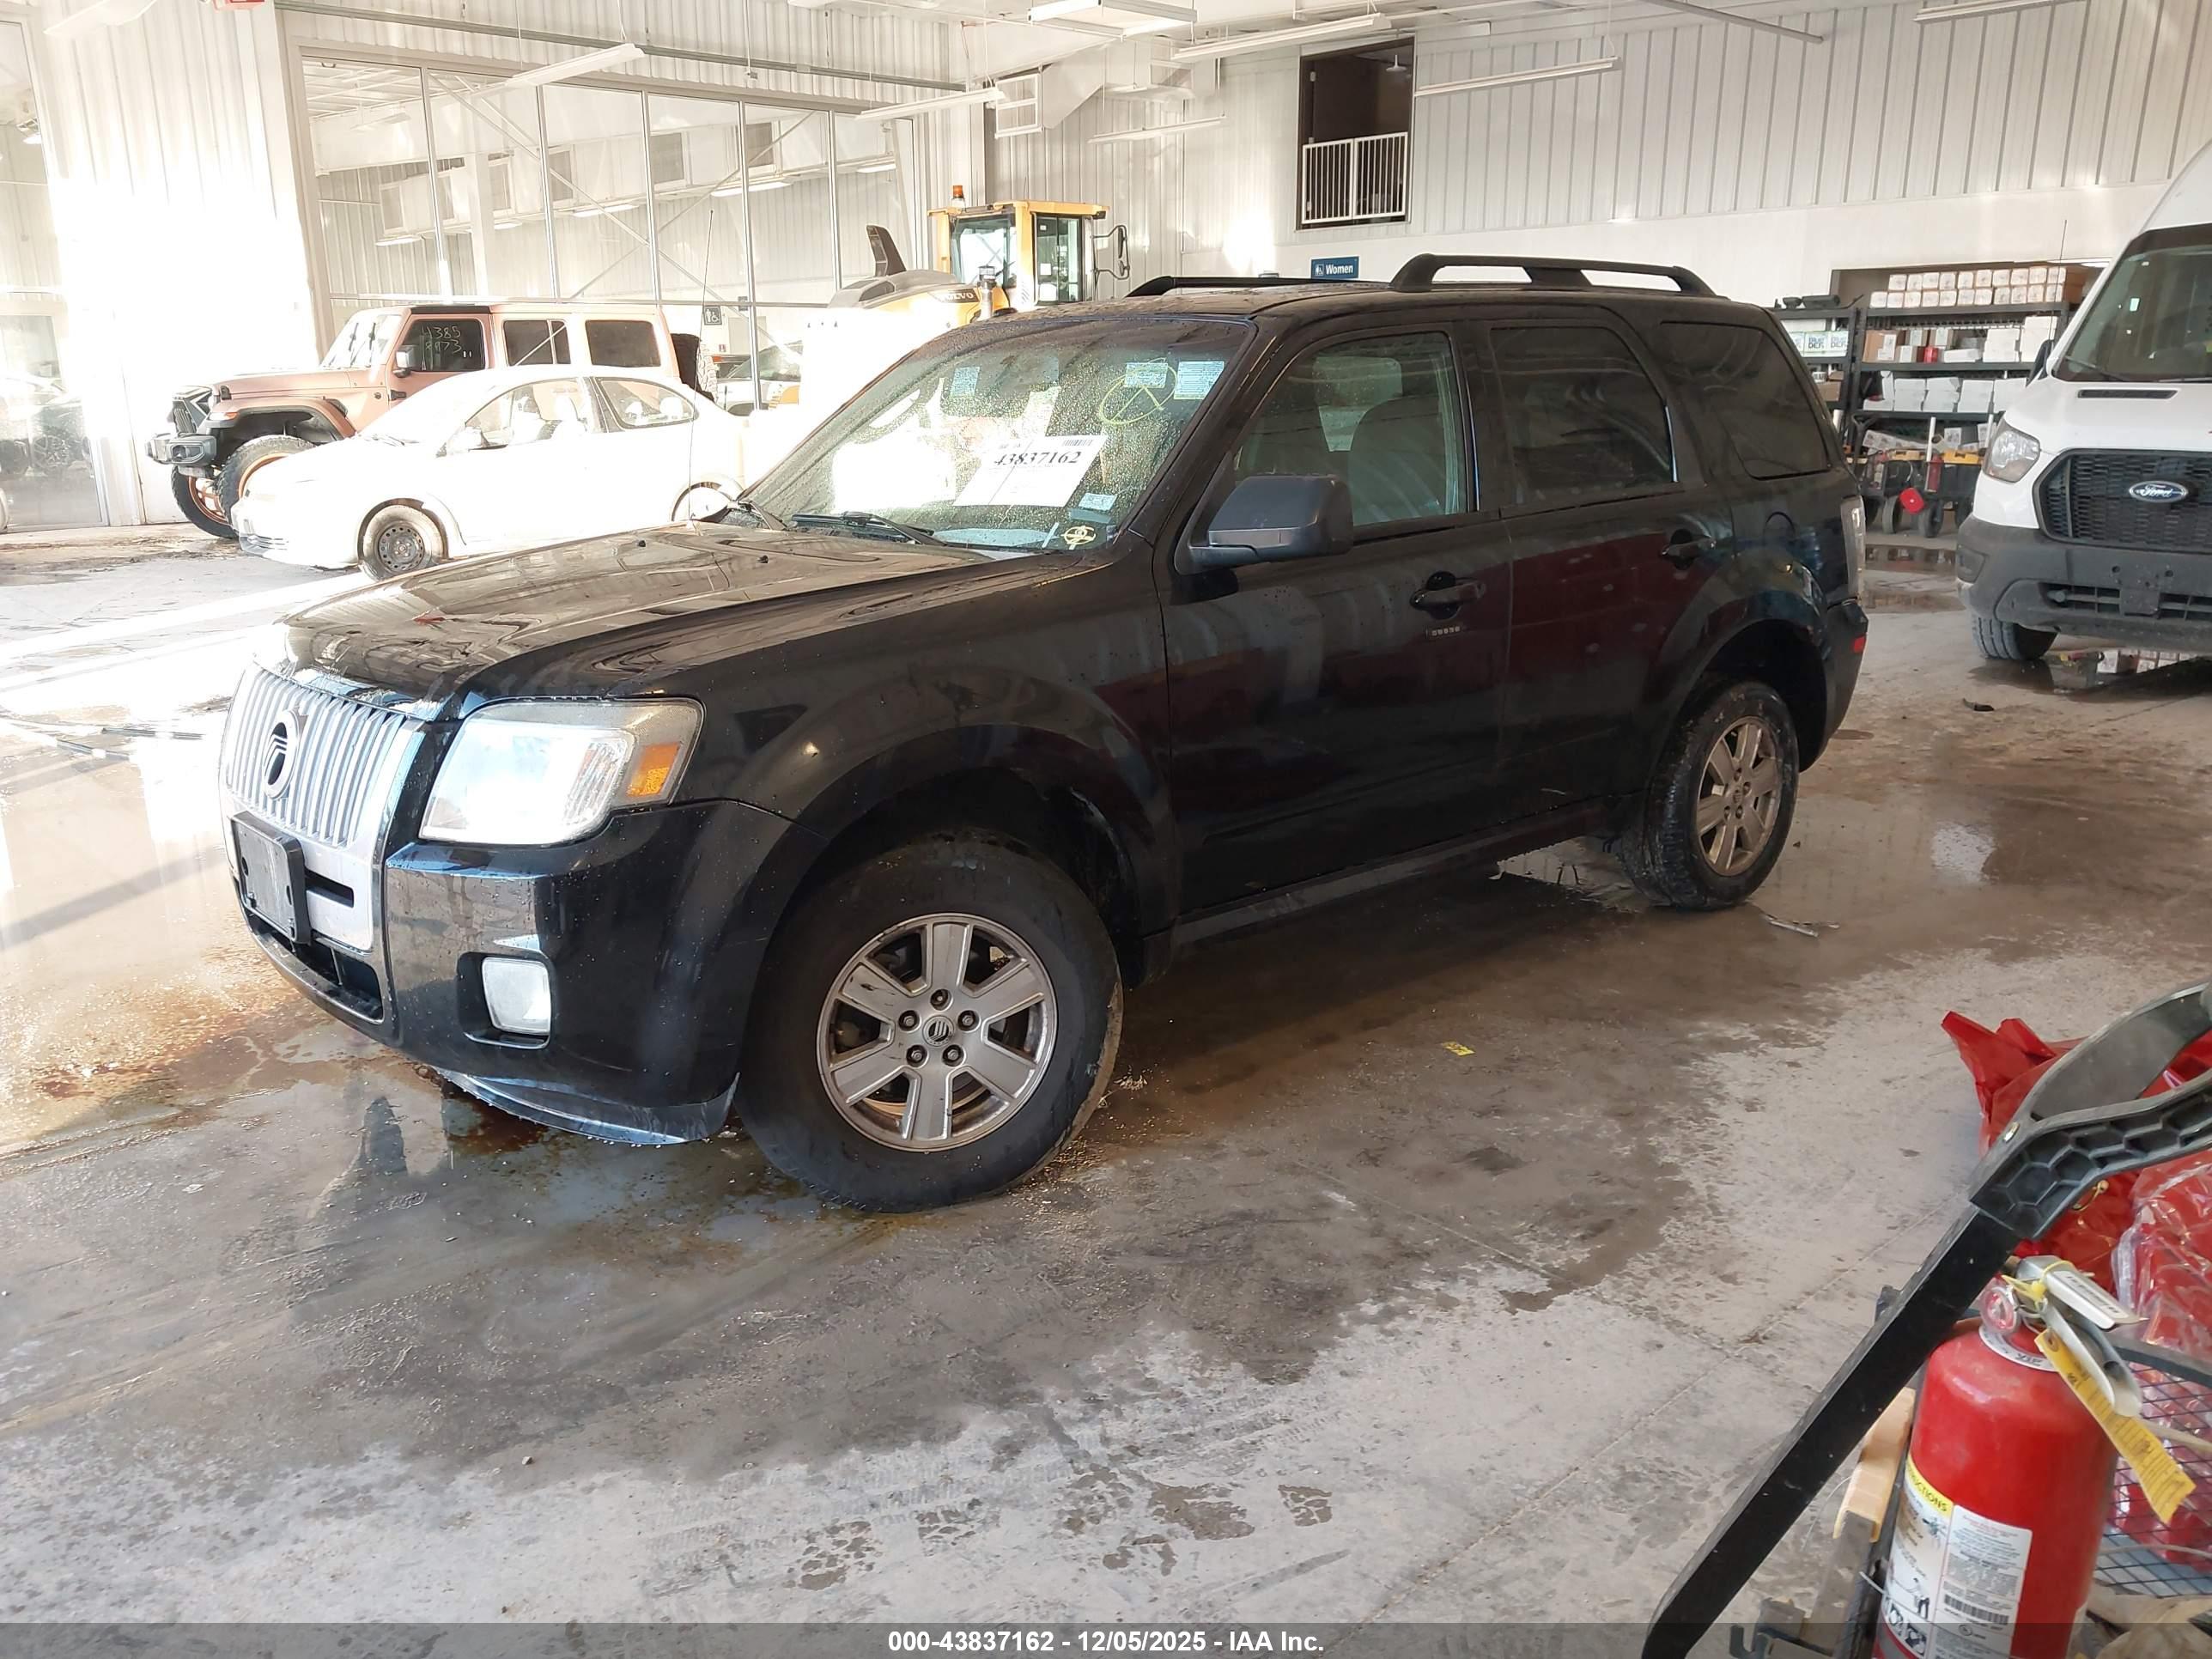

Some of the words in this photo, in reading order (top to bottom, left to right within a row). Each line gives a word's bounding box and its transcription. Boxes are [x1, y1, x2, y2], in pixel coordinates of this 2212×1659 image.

[1325, 264, 1354, 275] Women
[939, 292, 975, 301] OLVO
[422, 325, 462, 340] 4385
[994, 451, 1082, 466] 43837162
[2135, 483, 2177, 498] Ford
[1908, 1463, 1948, 1512] UCTIONS
